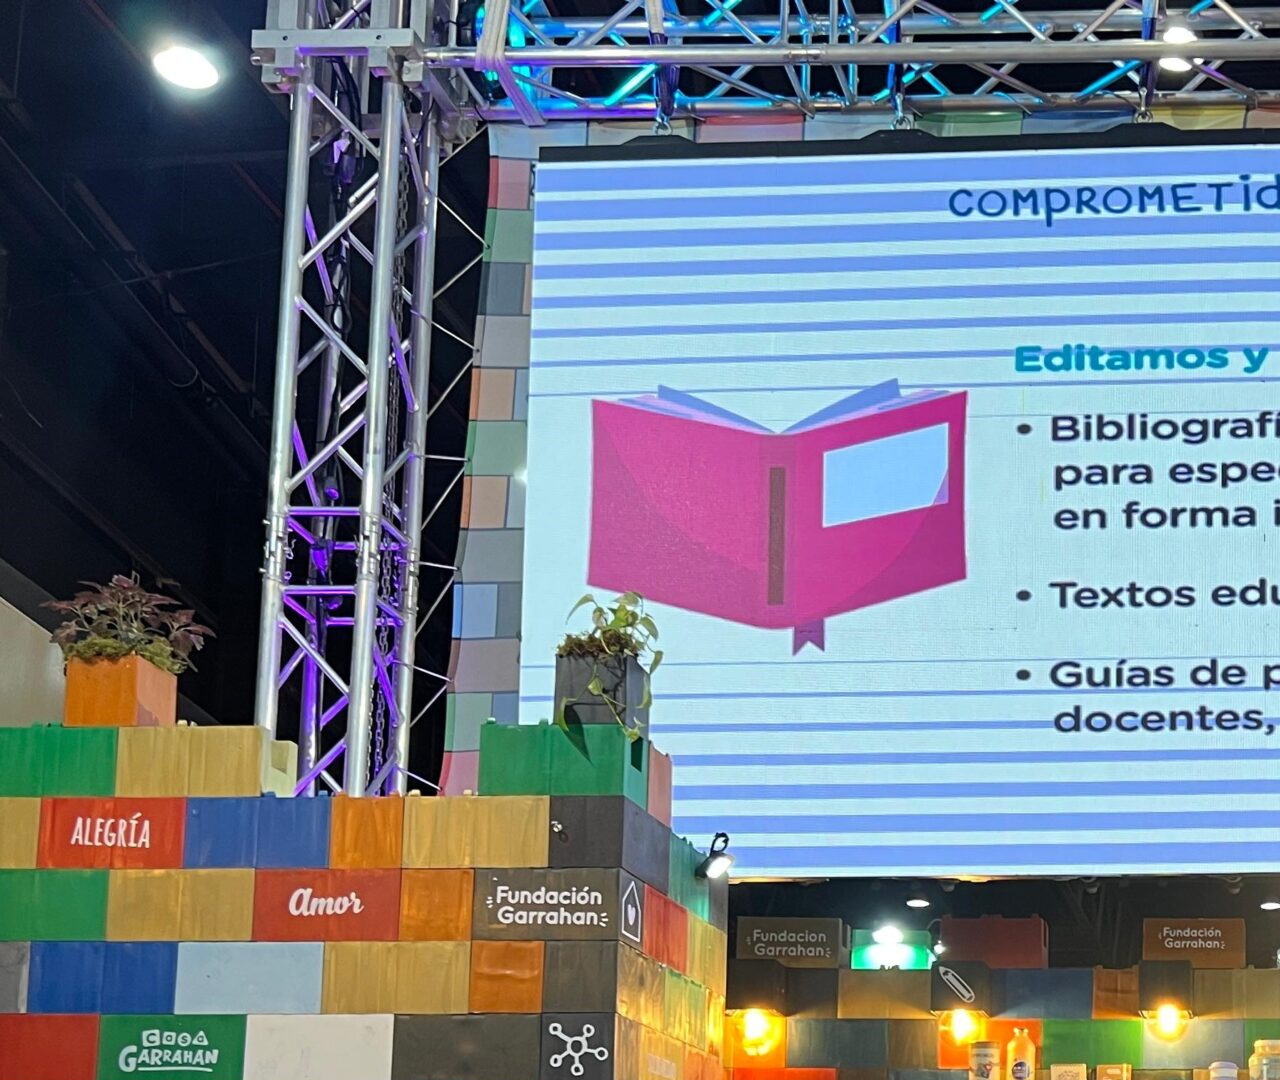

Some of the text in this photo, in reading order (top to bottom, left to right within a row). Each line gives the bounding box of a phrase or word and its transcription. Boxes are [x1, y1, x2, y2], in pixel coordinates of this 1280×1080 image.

[1015, 343, 1229, 374] Editamos
[1243, 347, 1268, 375] y
[1055, 461, 1153, 492] para
[1054, 506, 1107, 530] en
[1123, 501, 1256, 529] forma
[1049, 581, 1196, 609] Textos
[1051, 657, 1174, 688] Guías
[1190, 658, 1247, 687] de
[1053, 705, 1275, 736] docentes,
[71, 812, 151, 849] ALEGRÍA
[288, 886, 365, 918] Amor
[495, 885, 603, 907] Fundación
[497, 905, 600, 927] Garrahan
[754, 943, 825, 957] Garrahan
[1164, 938, 1220, 949] Garrahan
[143, 1029, 207, 1047] Casa
